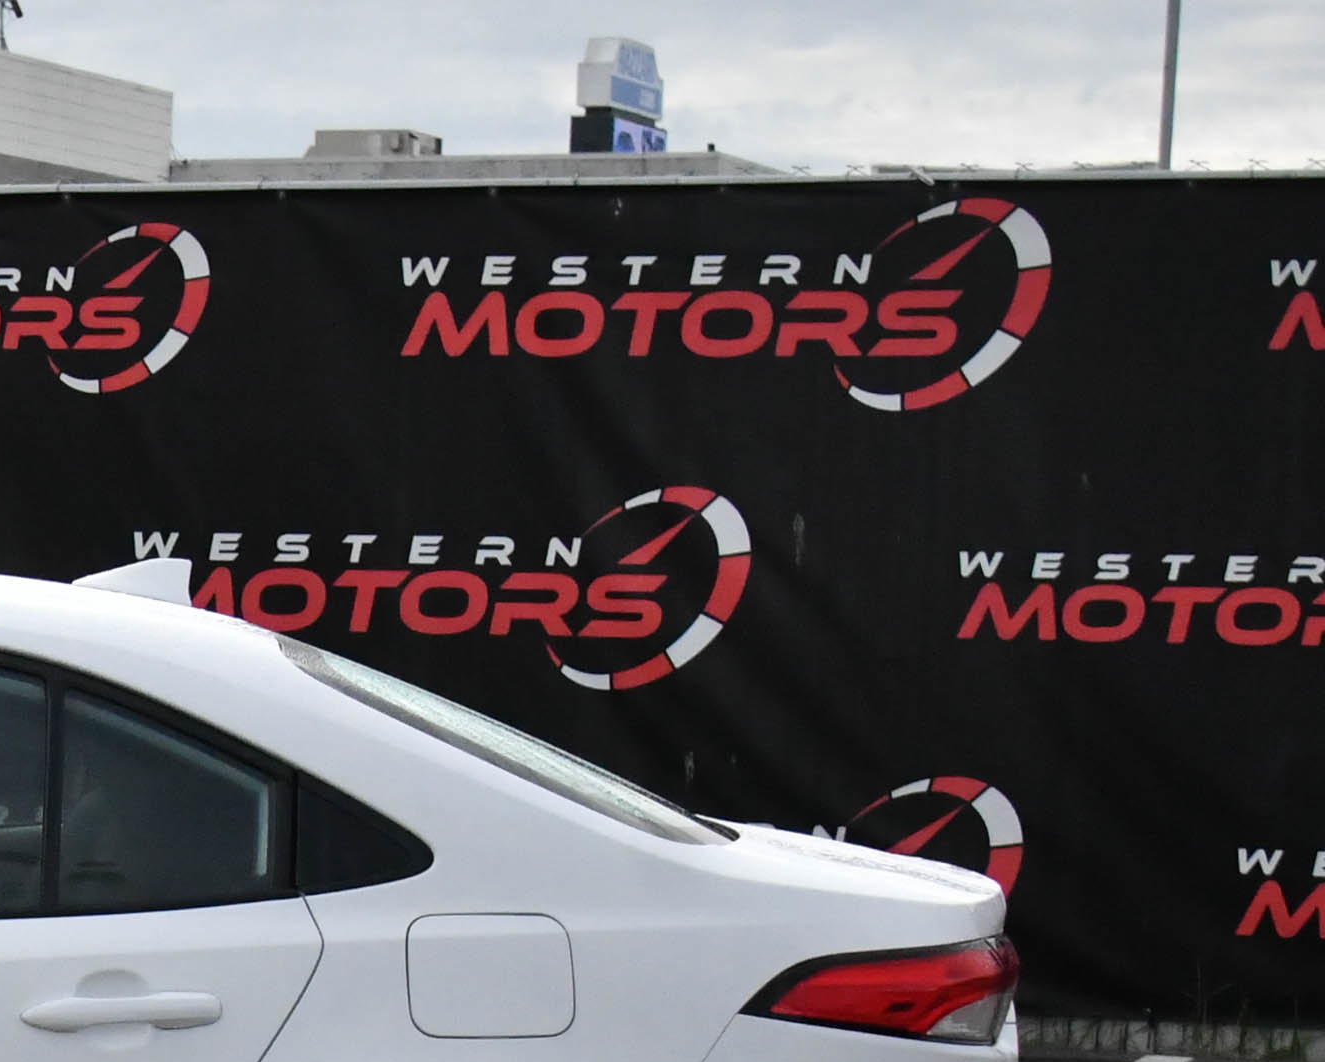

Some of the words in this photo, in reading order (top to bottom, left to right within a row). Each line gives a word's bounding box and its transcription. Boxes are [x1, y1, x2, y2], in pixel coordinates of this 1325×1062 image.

[401, 254, 873, 286] WESTERN
[401, 290, 963, 357] MOTORS
[133, 531, 582, 567] WESTERN
